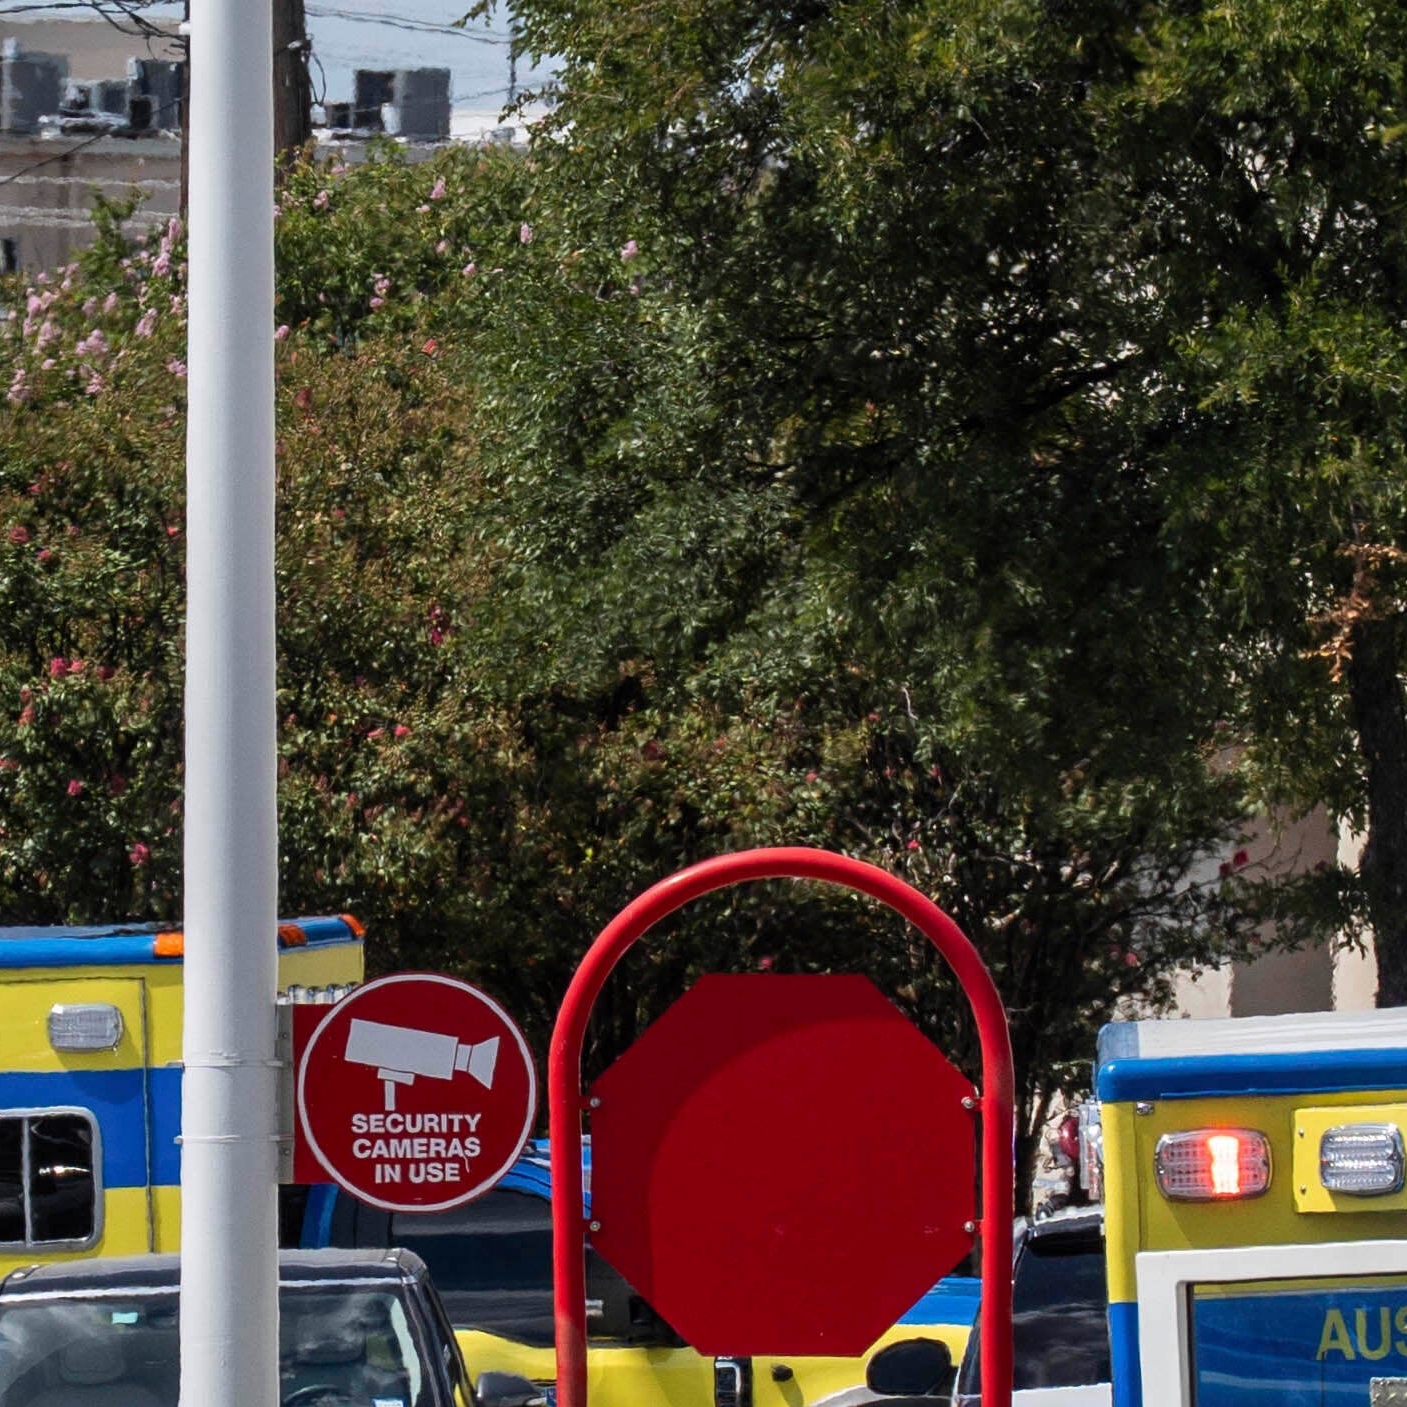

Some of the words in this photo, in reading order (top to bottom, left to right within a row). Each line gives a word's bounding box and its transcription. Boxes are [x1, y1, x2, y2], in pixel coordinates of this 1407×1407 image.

[351, 1113, 481, 1133] SECURITY
[353, 1137, 481, 1158] CAMERAS
[375, 1164, 401, 1184] IN
[409, 1162, 460, 1183] USE
